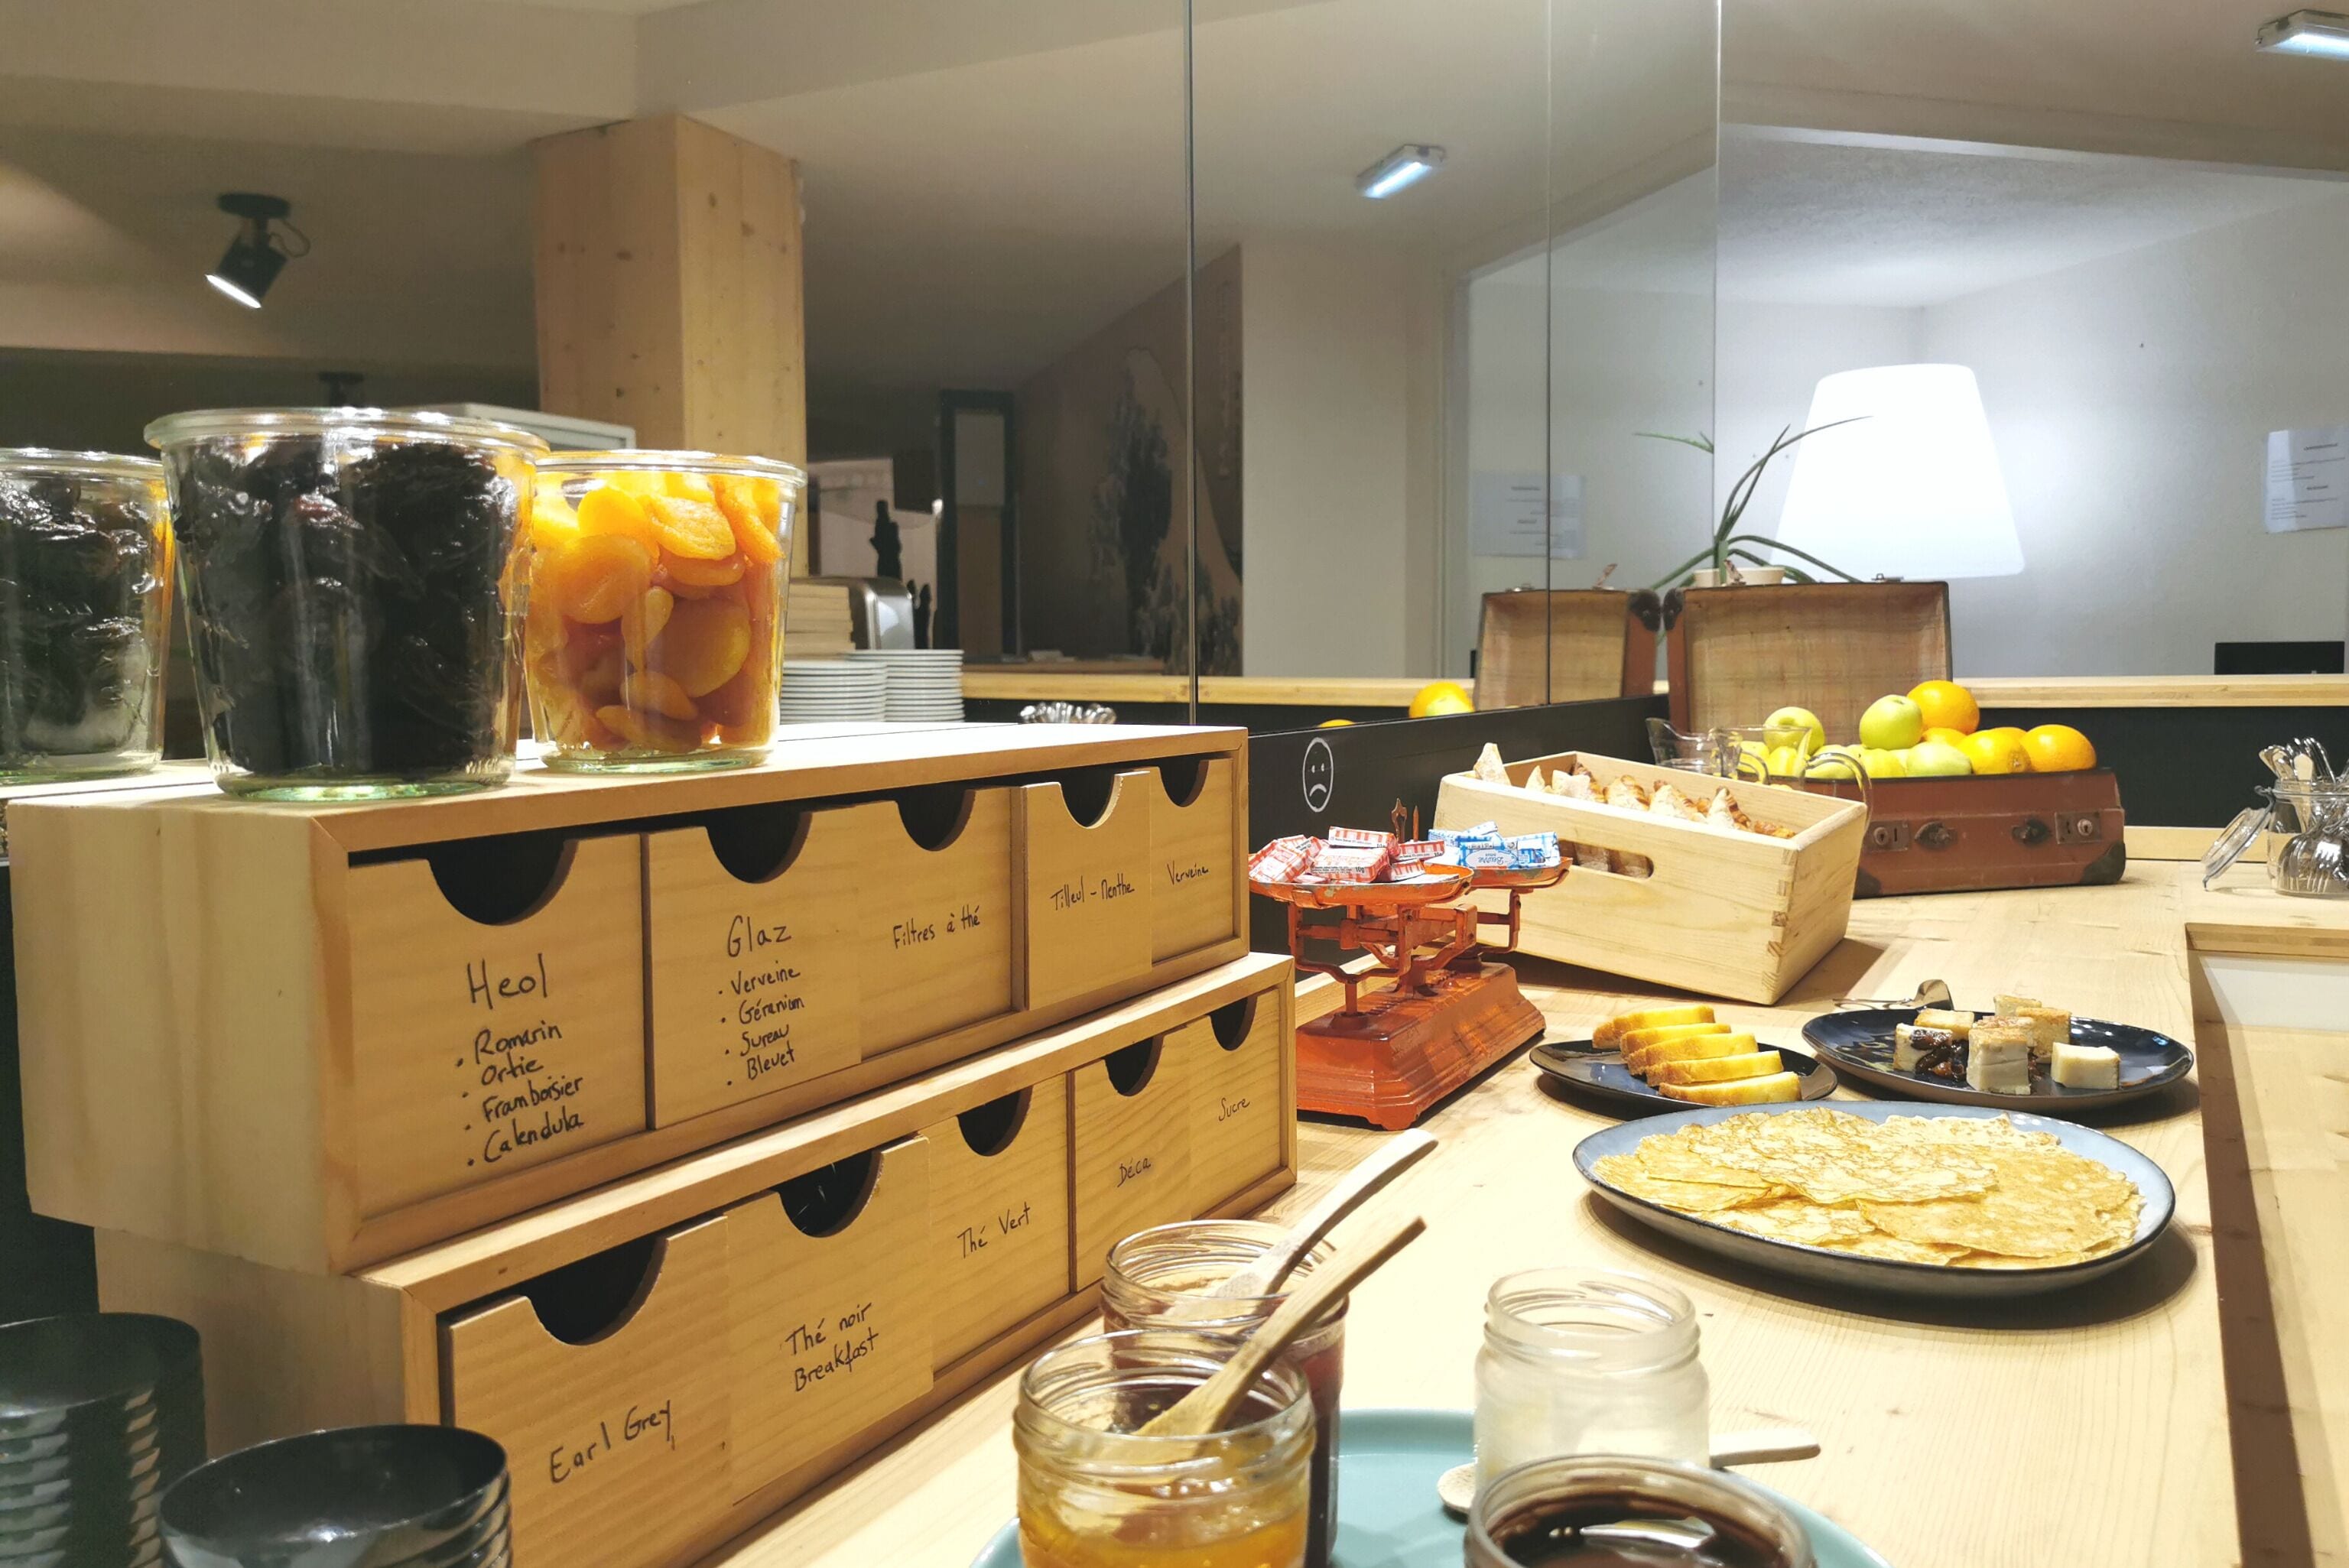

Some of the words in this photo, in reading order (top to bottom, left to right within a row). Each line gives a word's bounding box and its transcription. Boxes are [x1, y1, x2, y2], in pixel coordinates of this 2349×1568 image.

[1167, 860, 1209, 885] Verveine
[1477, 856, 1504, 865] Beurre
[1050, 875, 1085, 911] Tilleul
[727, 915, 791, 957] Glaz
[893, 917, 935, 949] Filtres
[947, 912, 955, 933] à
[960, 904, 980, 930] thé
[467, 953, 547, 1010] Heol
[731, 959, 801, 995] Verveine
[739, 995, 804, 1024] Géranium
[474, 1020, 562, 1064] Romarin
[740, 1024, 790, 1057] Sureau
[746, 1040, 794, 1080] Bleuet
[481, 1052, 544, 1086] Ortie
[482, 1075, 583, 1122] Framboisier
[1218, 1097, 1250, 1122] Sucre
[484, 1105, 584, 1162] Calendula
[1117, 1157, 1152, 1187] Déca
[957, 1226, 988, 1259] Thé
[999, 1201, 1031, 1235] Vert
[785, 1317, 827, 1355] Thé
[839, 1302, 872, 1331] noir
[794, 1326, 879, 1392] Breakfast
[551, 1421, 611, 1484] Earl
[625, 1399, 671, 1442] Grey
